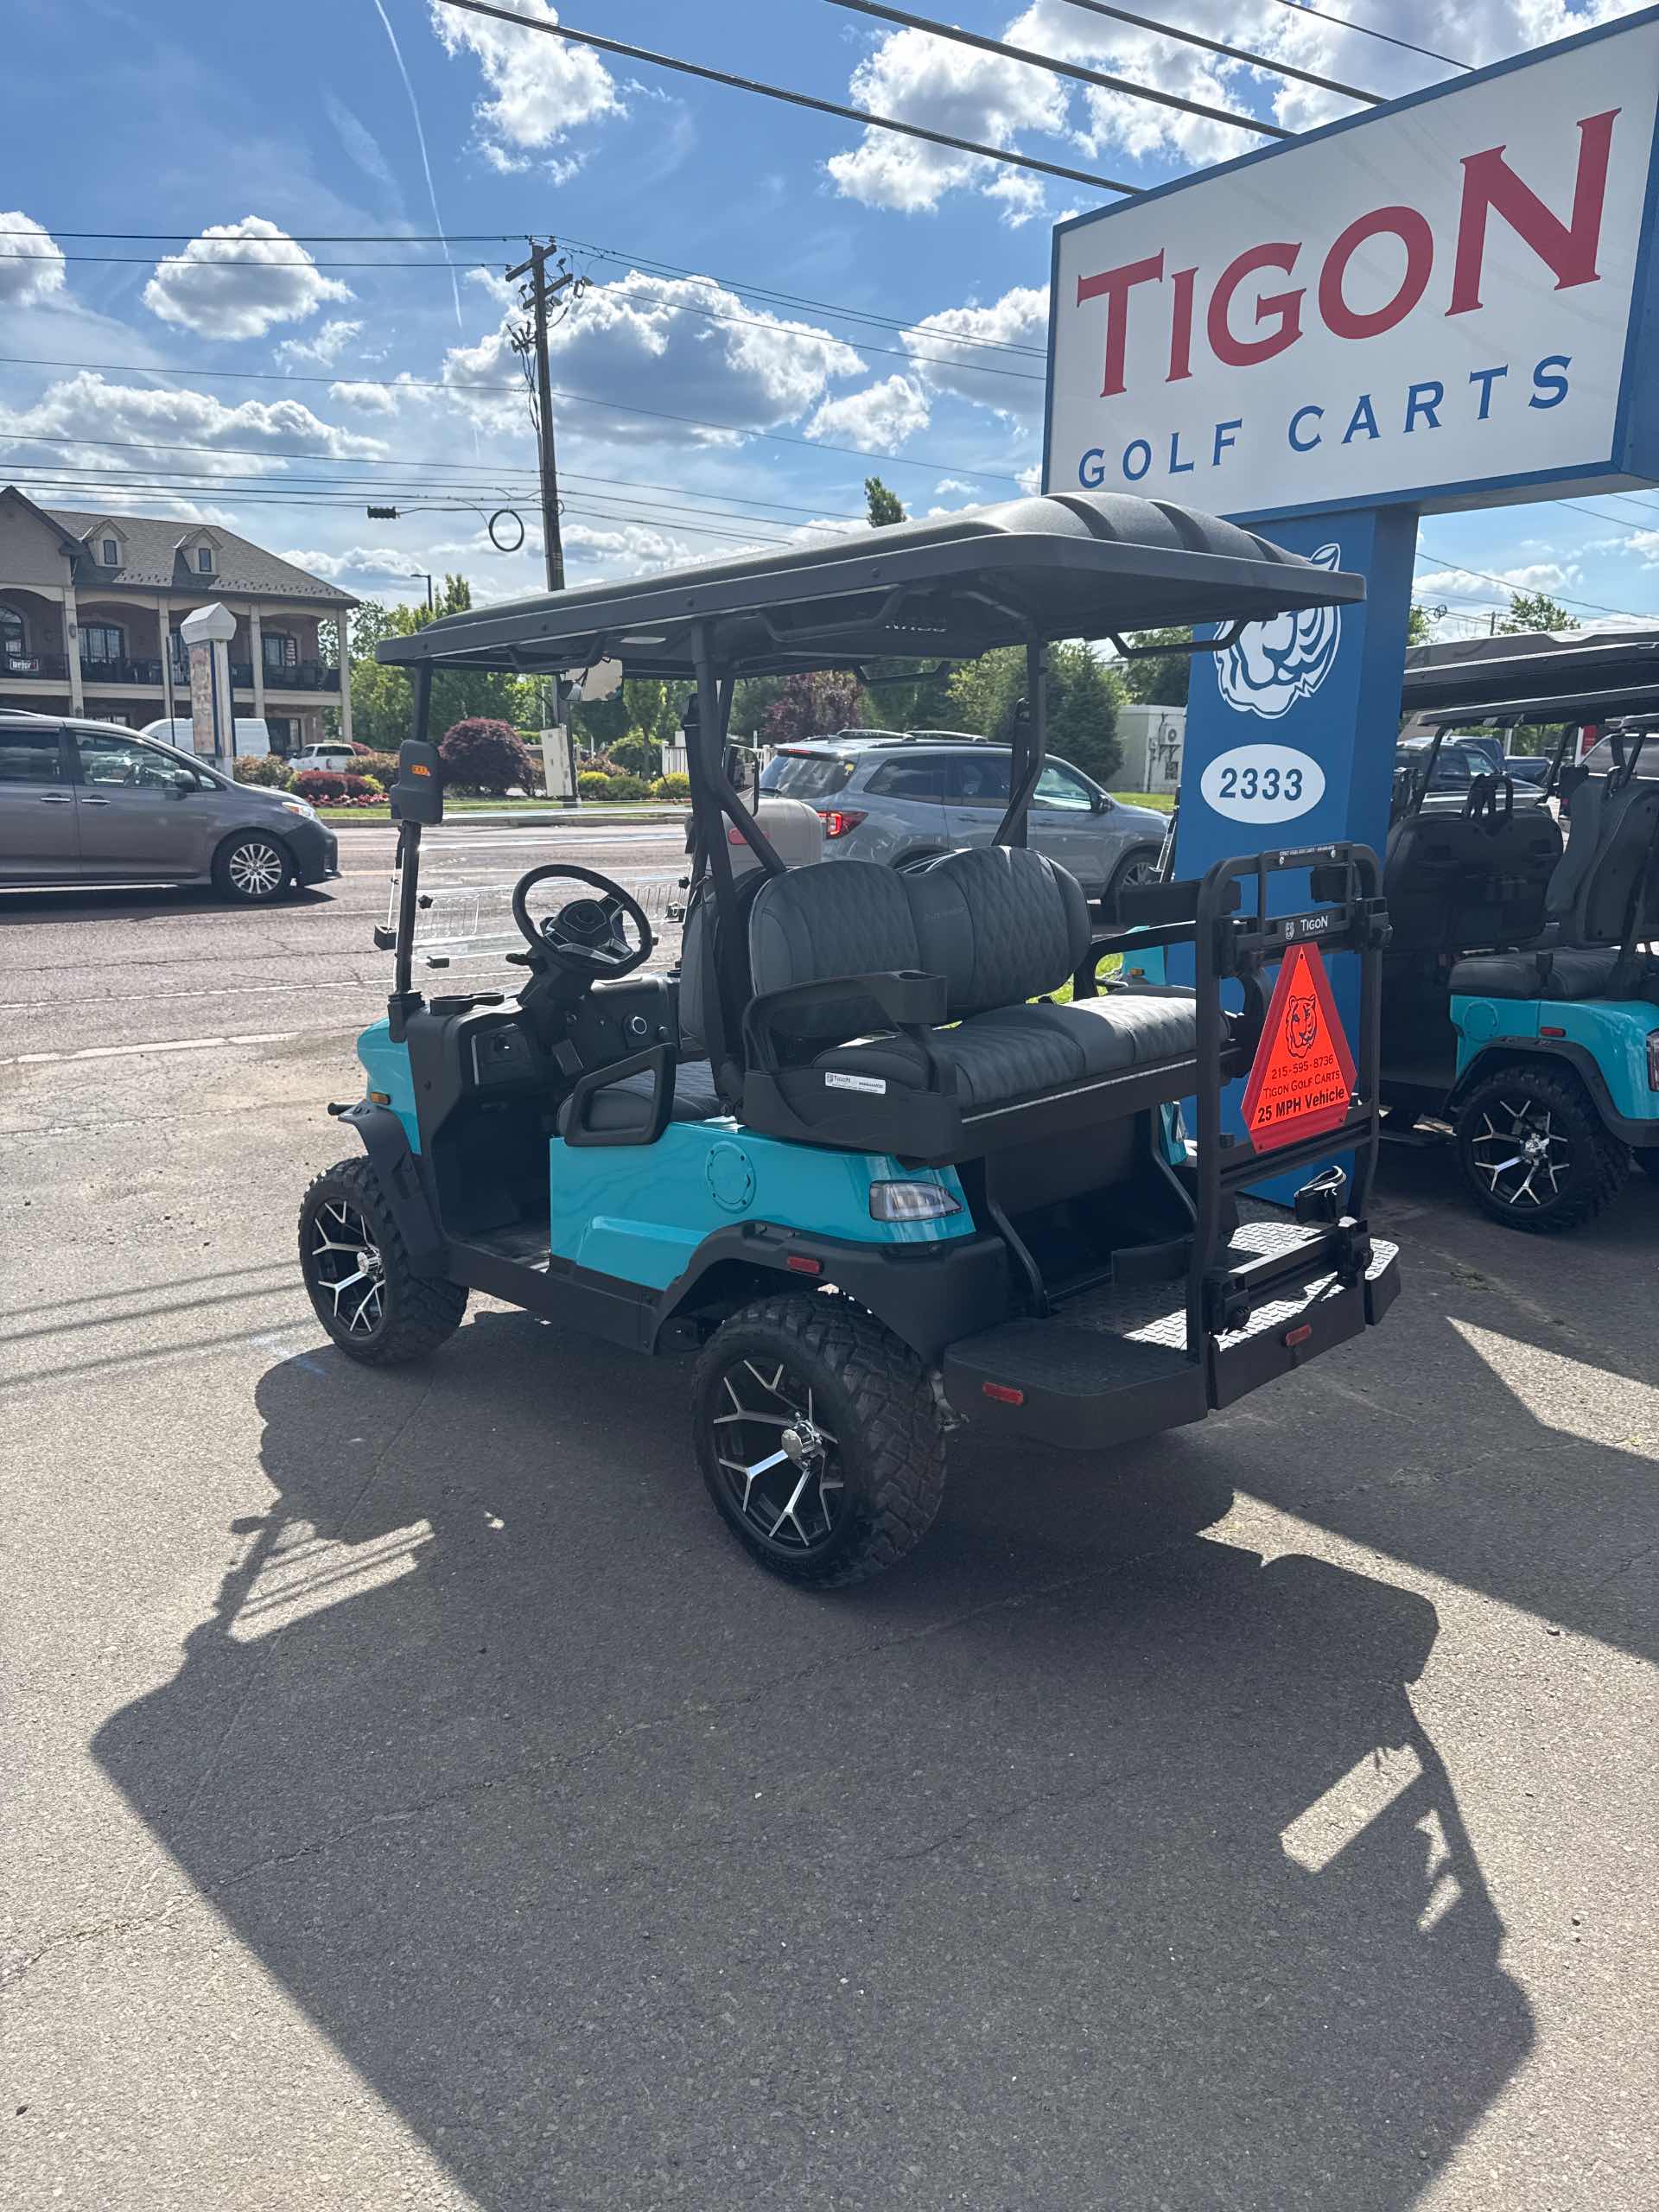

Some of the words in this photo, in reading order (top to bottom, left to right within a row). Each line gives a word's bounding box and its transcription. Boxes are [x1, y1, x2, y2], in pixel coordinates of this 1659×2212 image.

[1077, 107, 1623, 397] TIGON
[1078, 418, 1243, 489] GOLF
[1287, 355, 1572, 452] CARTS
[1219, 767, 1303, 801] 2333
[1300, 915, 1328, 931] TIGON
[1262, 1083, 1289, 1100] TIGON
[1290, 1077, 1313, 1091] GOLF
[1314, 1070, 1340, 1085] CARTS
[1257, 1105, 1273, 1123] 25
[1275, 1096, 1301, 1118] MPH
[1305, 1085, 1344, 1109] Vehicle
